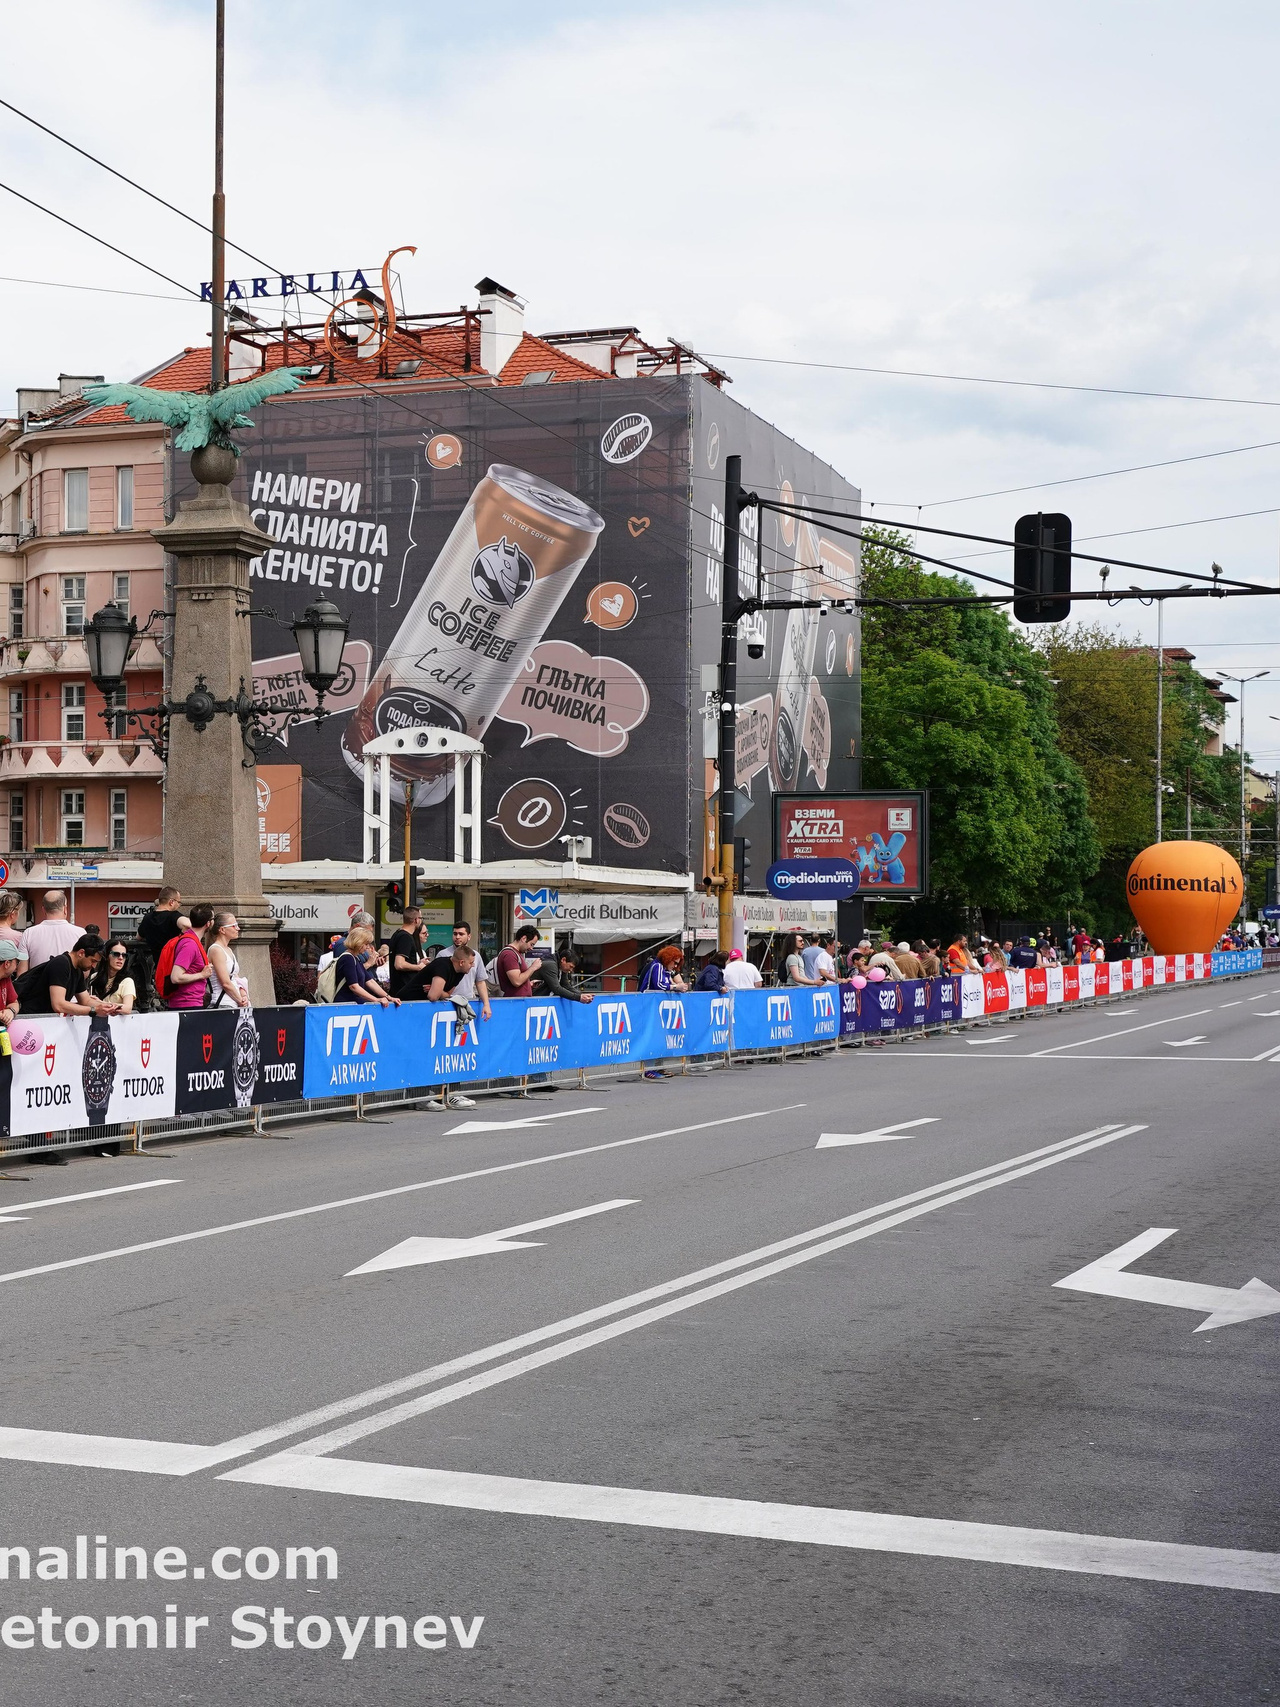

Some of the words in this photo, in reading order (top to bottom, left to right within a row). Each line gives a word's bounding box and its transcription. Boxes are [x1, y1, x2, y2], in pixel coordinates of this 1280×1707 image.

[200, 269, 370, 301] KARELIA
[251, 470, 362, 514] НАМЕРИ
[502, 513, 516, 526] HELL
[518, 523, 529, 533] ICE
[531, 529, 555, 545] COFFEE
[459, 597, 501, 631] ICE
[428, 601, 518, 663] COFFEE
[414, 647, 476, 695] Latte
[536, 664, 606, 700] ГЛЪТКА
[521, 686, 606, 726] ПОЧИВКА
[795, 809, 835, 819] ВЗЕМИ
[787, 820, 843, 837] XTRA
[777, 872, 853, 884] mediolanum
[1128, 873, 1226, 896] Continental
[269, 904, 318, 919] Bulbank
[555, 904, 596, 919] Credit
[600, 904, 658, 919] Bulbank
[768, 996, 792, 1022] ITA
[813, 992, 835, 1017] ITA
[879, 989, 895, 1010] sara
[526, 1006, 560, 1040] ITA
[598, 1002, 631, 1035] ITA
[814, 1020, 835, 1035] AIRWAYS
[327, 1015, 379, 1056] ITA
[771, 1025, 793, 1040] AIRWAYS
[528, 1045, 558, 1065] AIRWAYS
[600, 1039, 630, 1057] AIRWAYS
[264, 1062, 296, 1083] TUDOR
[329, 1061, 377, 1085] AIRWAYS
[434, 1053, 476, 1074] AIRWAYS
[123, 1076, 164, 1098] TUDOR
[188, 1069, 224, 1091] TUDOR
[26, 1084, 71, 1108] TUDOR
